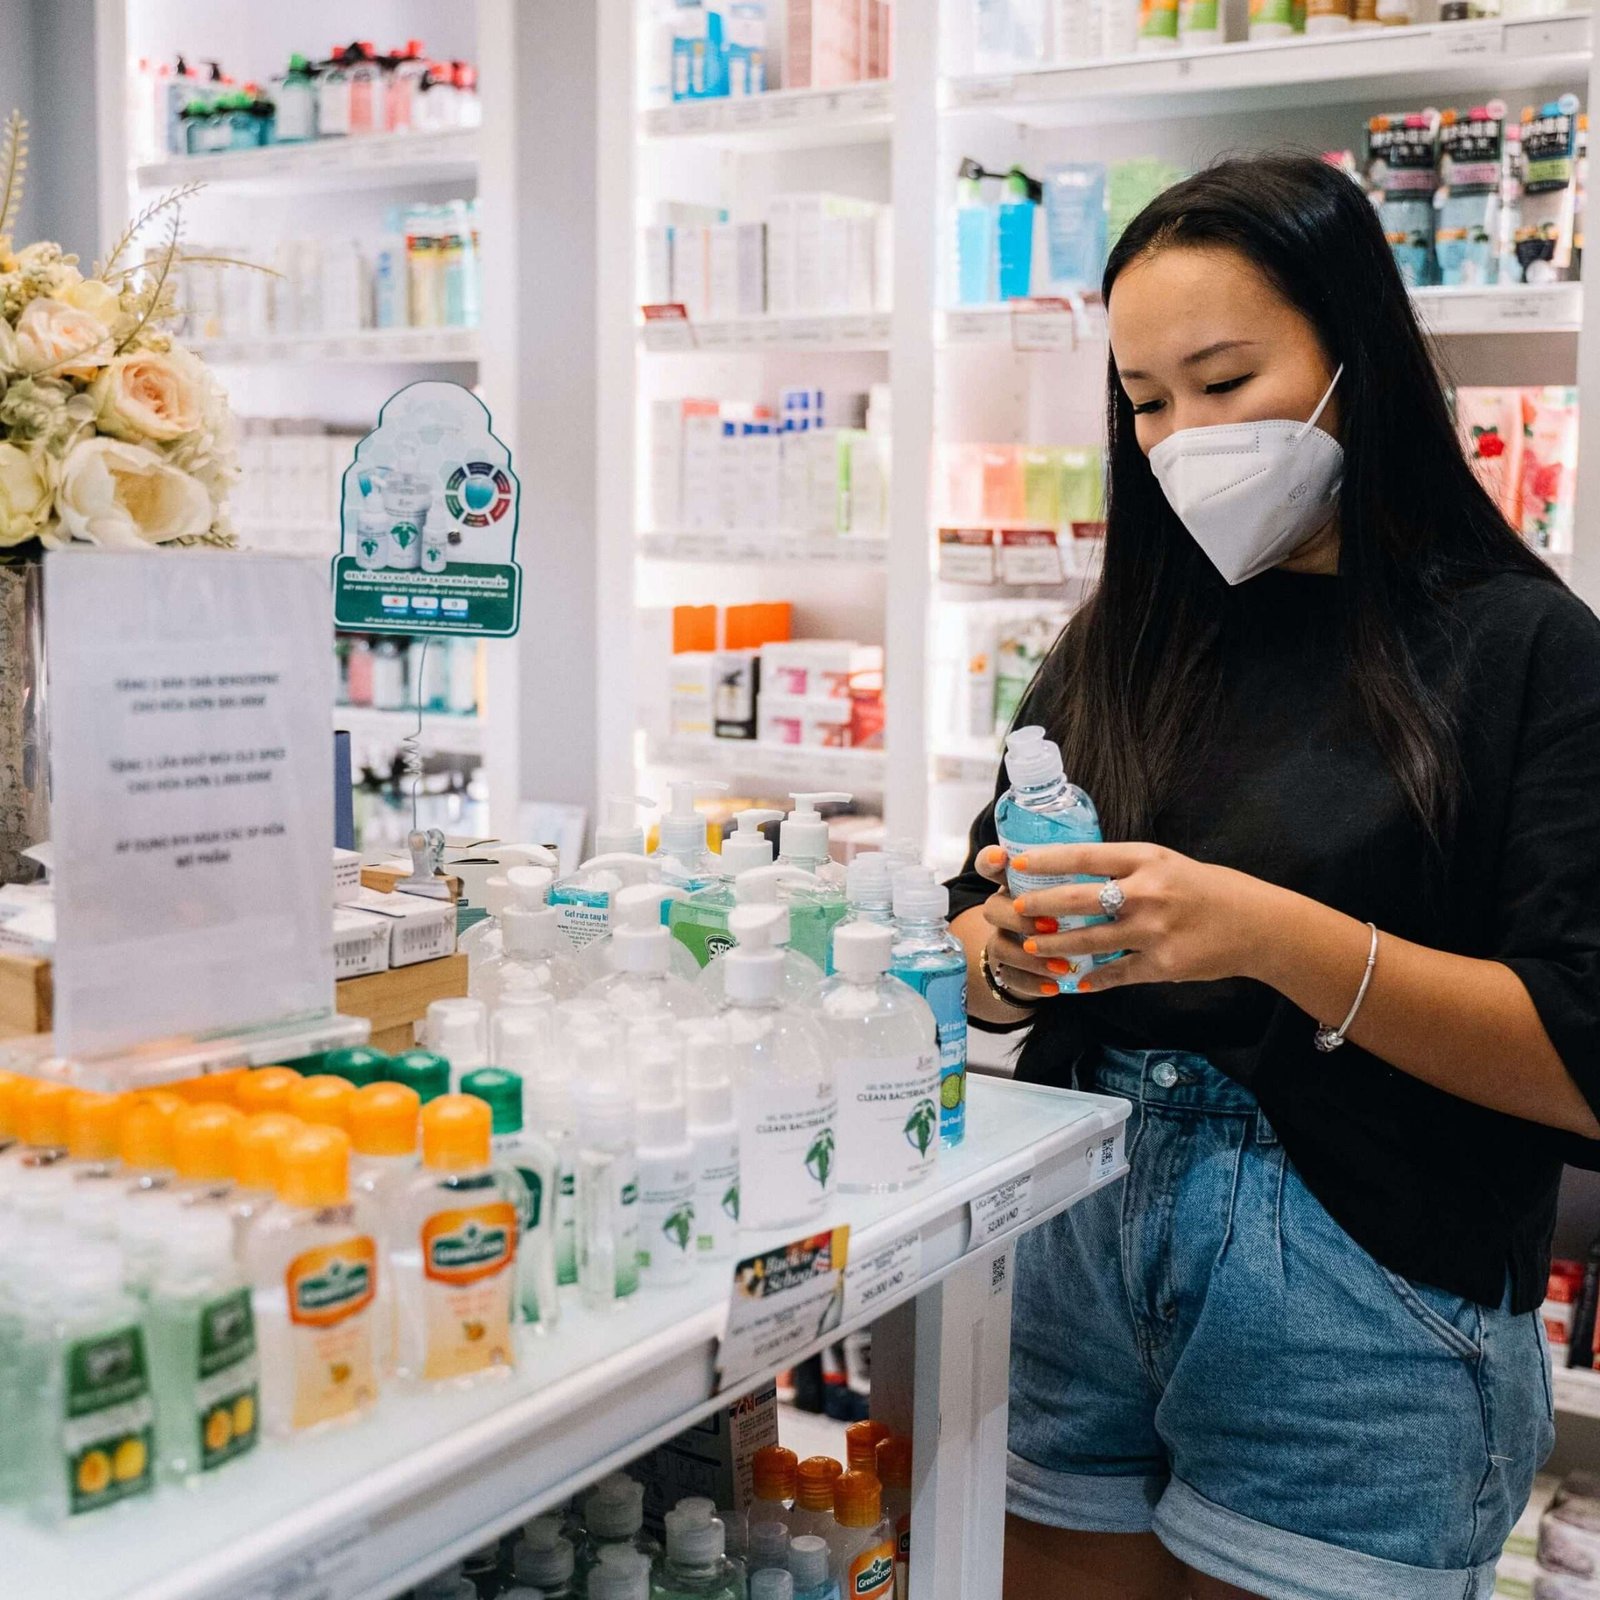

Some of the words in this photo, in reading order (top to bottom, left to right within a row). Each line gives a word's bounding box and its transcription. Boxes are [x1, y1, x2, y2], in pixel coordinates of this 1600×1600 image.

[856, 1093, 887, 1102] CLEAN
[755, 1123, 787, 1135] CLEAN
[858, 1567, 892, 1588] GreenCross
